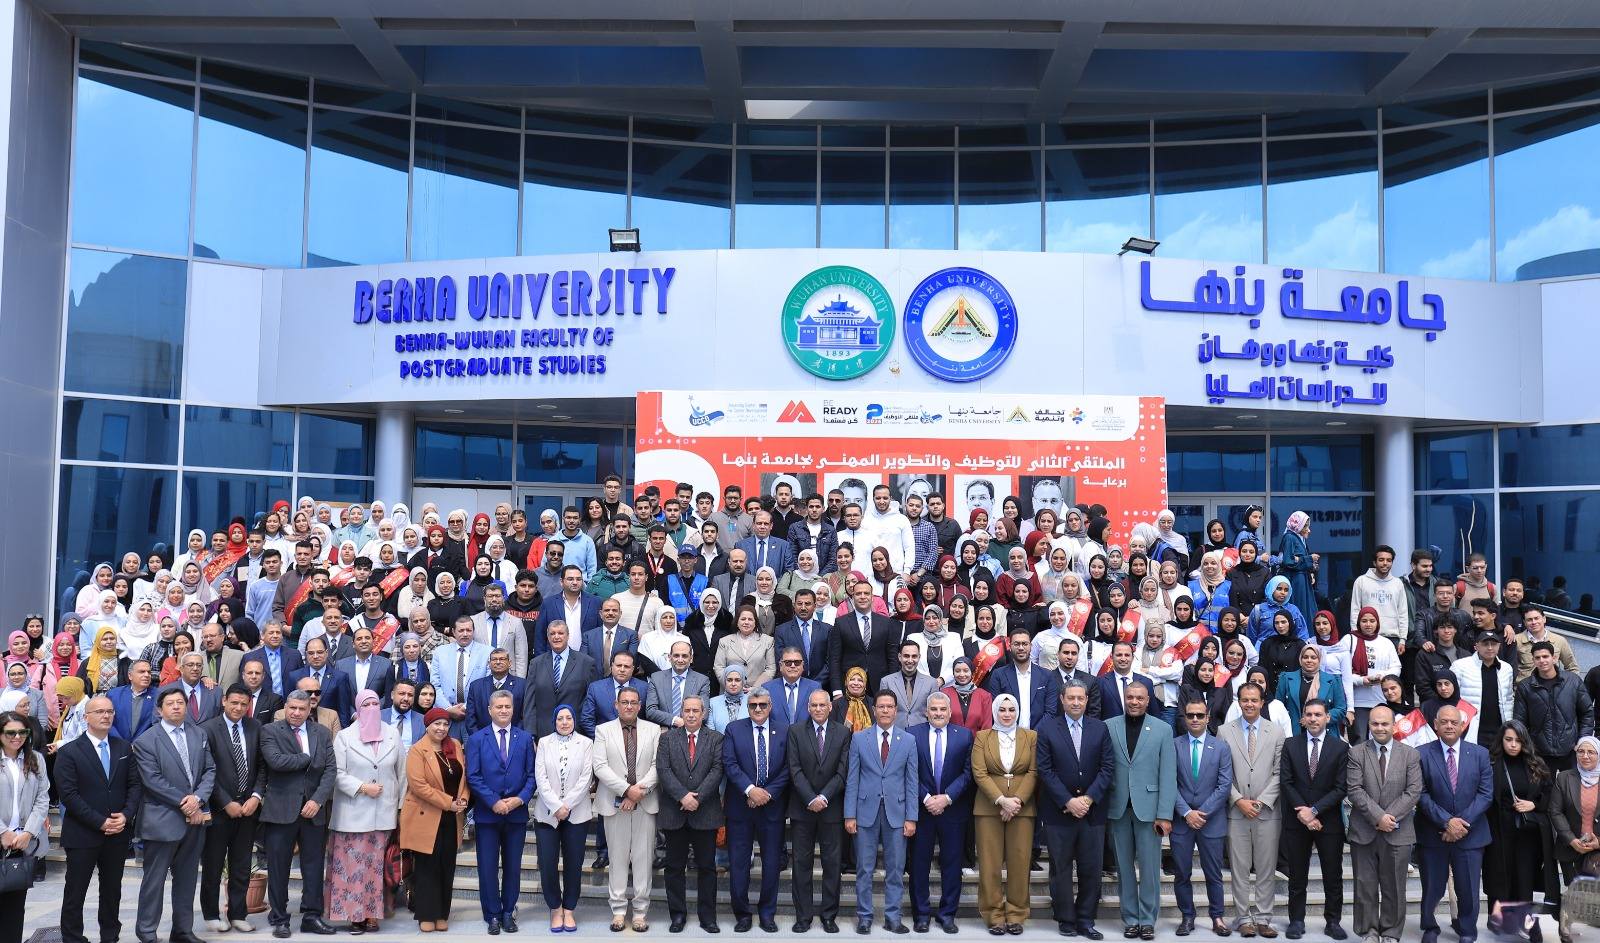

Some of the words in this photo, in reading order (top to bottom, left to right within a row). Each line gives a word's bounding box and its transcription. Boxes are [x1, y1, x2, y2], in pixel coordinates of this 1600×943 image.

[353, 274, 457, 324] BENHA
[467, 267, 676, 320] UNIVERSITY
[791, 275, 828, 311] WUHAN
[829, 272, 889, 314] UNIVERSITY
[910, 280, 943, 317] BENHA
[947, 274, 1012, 322] UNIVERSITY
[1140, 260, 1265, 328] بنها
[1280, 268, 1447, 341] جامعة
[395, 330, 516, 353] BENHA-WUHAN
[520, 327, 588, 348] FACULTY
[593, 327, 615, 346] OF
[825, 349, 851, 357] 1893
[1334, 340, 1394, 374] كلية
[400, 355, 533, 380] POSTGRADUATE
[538, 354, 607, 376] STUDIES
[1206, 373, 1276, 404] العليا
[1278, 376, 1387, 407] للدراسات
[823, 407, 858, 415] READY
[948, 404, 969, 417] بنها
[970, 405, 1001, 419] جامعة
[1034, 408, 1065, 416] تحالف
[1034, 415, 1065, 423] وتنمية
[722, 452, 758, 469] بنها
[761, 453, 813, 470] بجامعة
[882, 453, 950, 470] والتطوير
[955, 455, 1021, 471] للتوظيف
[1071, 456, 1125, 473] الملتقى
[1083, 476, 1127, 488] برعاية
